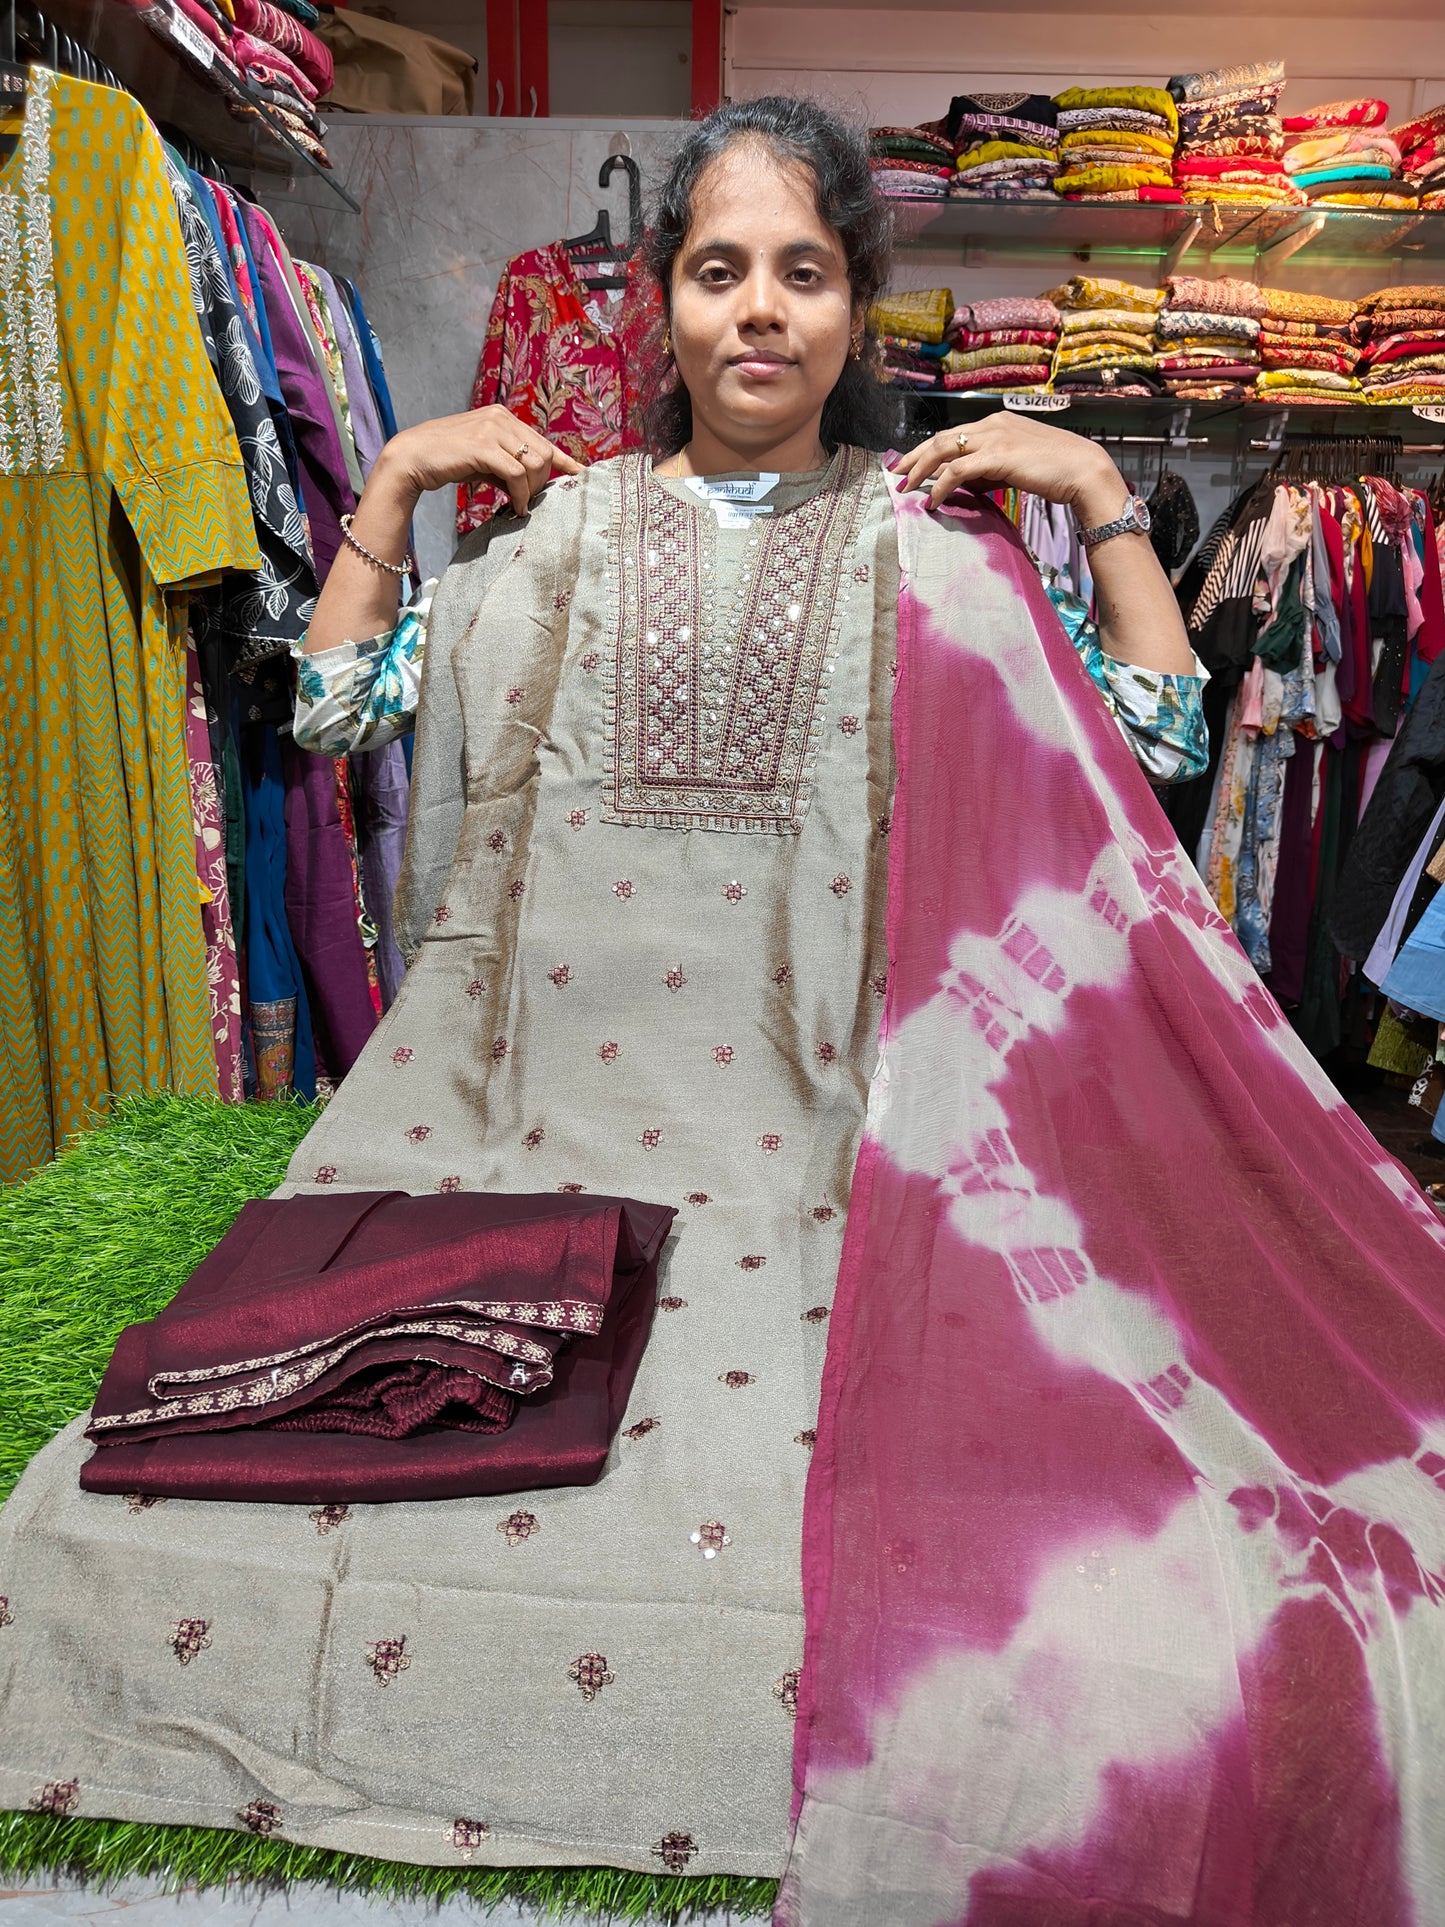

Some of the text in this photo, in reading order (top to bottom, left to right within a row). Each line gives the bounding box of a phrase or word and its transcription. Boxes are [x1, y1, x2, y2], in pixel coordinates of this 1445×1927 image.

[1008, 395, 1021, 405] XL
[1418, 407, 1445, 416] XL SI
